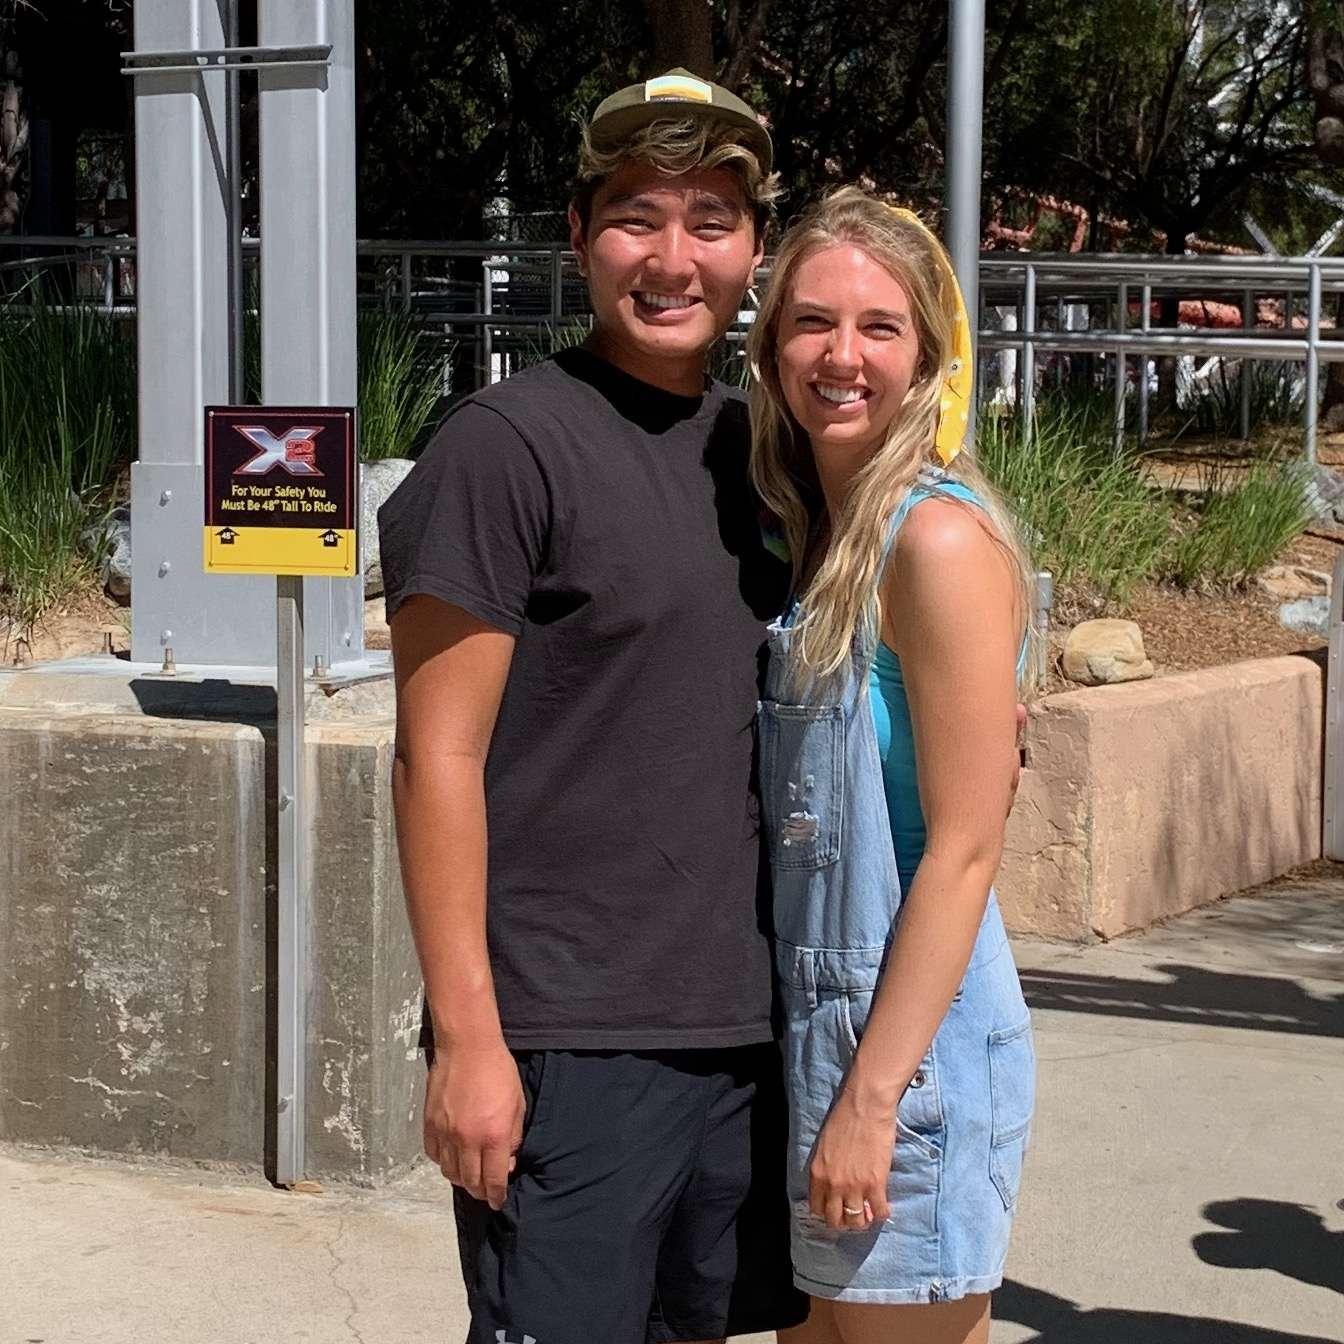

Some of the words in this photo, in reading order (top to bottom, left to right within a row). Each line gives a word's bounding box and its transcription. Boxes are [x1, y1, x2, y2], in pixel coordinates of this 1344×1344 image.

[231, 424, 326, 477] X2
[231, 485, 249, 496] For
[250, 486, 272, 497] Your
[274, 485, 305, 499] Safety
[307, 487, 326, 498] You
[221, 500, 245, 511] Must
[247, 500, 260, 511] Be
[281, 501, 298, 512] Tall
[299, 501, 311, 512] To
[313, 501, 337, 512] Ride
